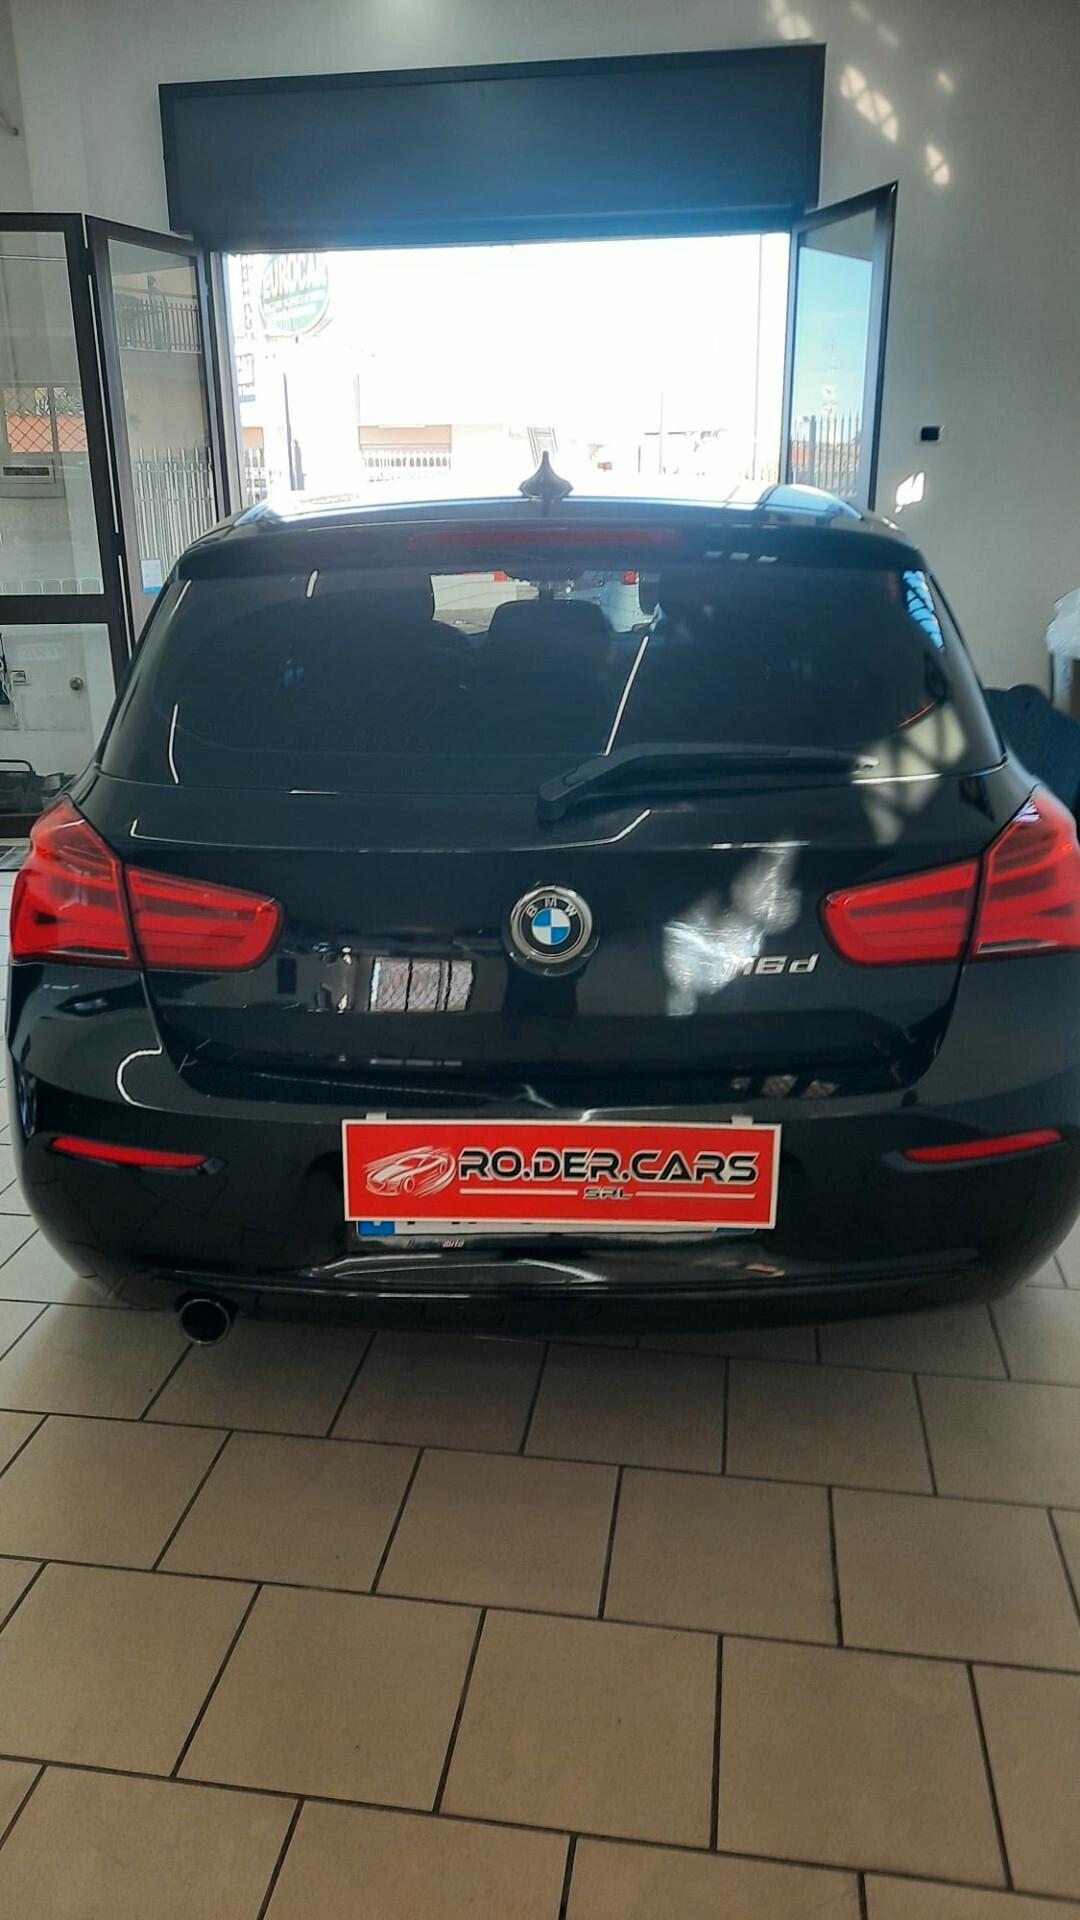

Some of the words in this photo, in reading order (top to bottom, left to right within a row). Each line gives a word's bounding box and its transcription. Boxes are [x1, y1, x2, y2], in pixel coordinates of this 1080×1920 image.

[525, 895, 577, 918] BMW
[458, 1147, 759, 1185] RO.DER.CARS
[583, 1186, 633, 1200] SRL
